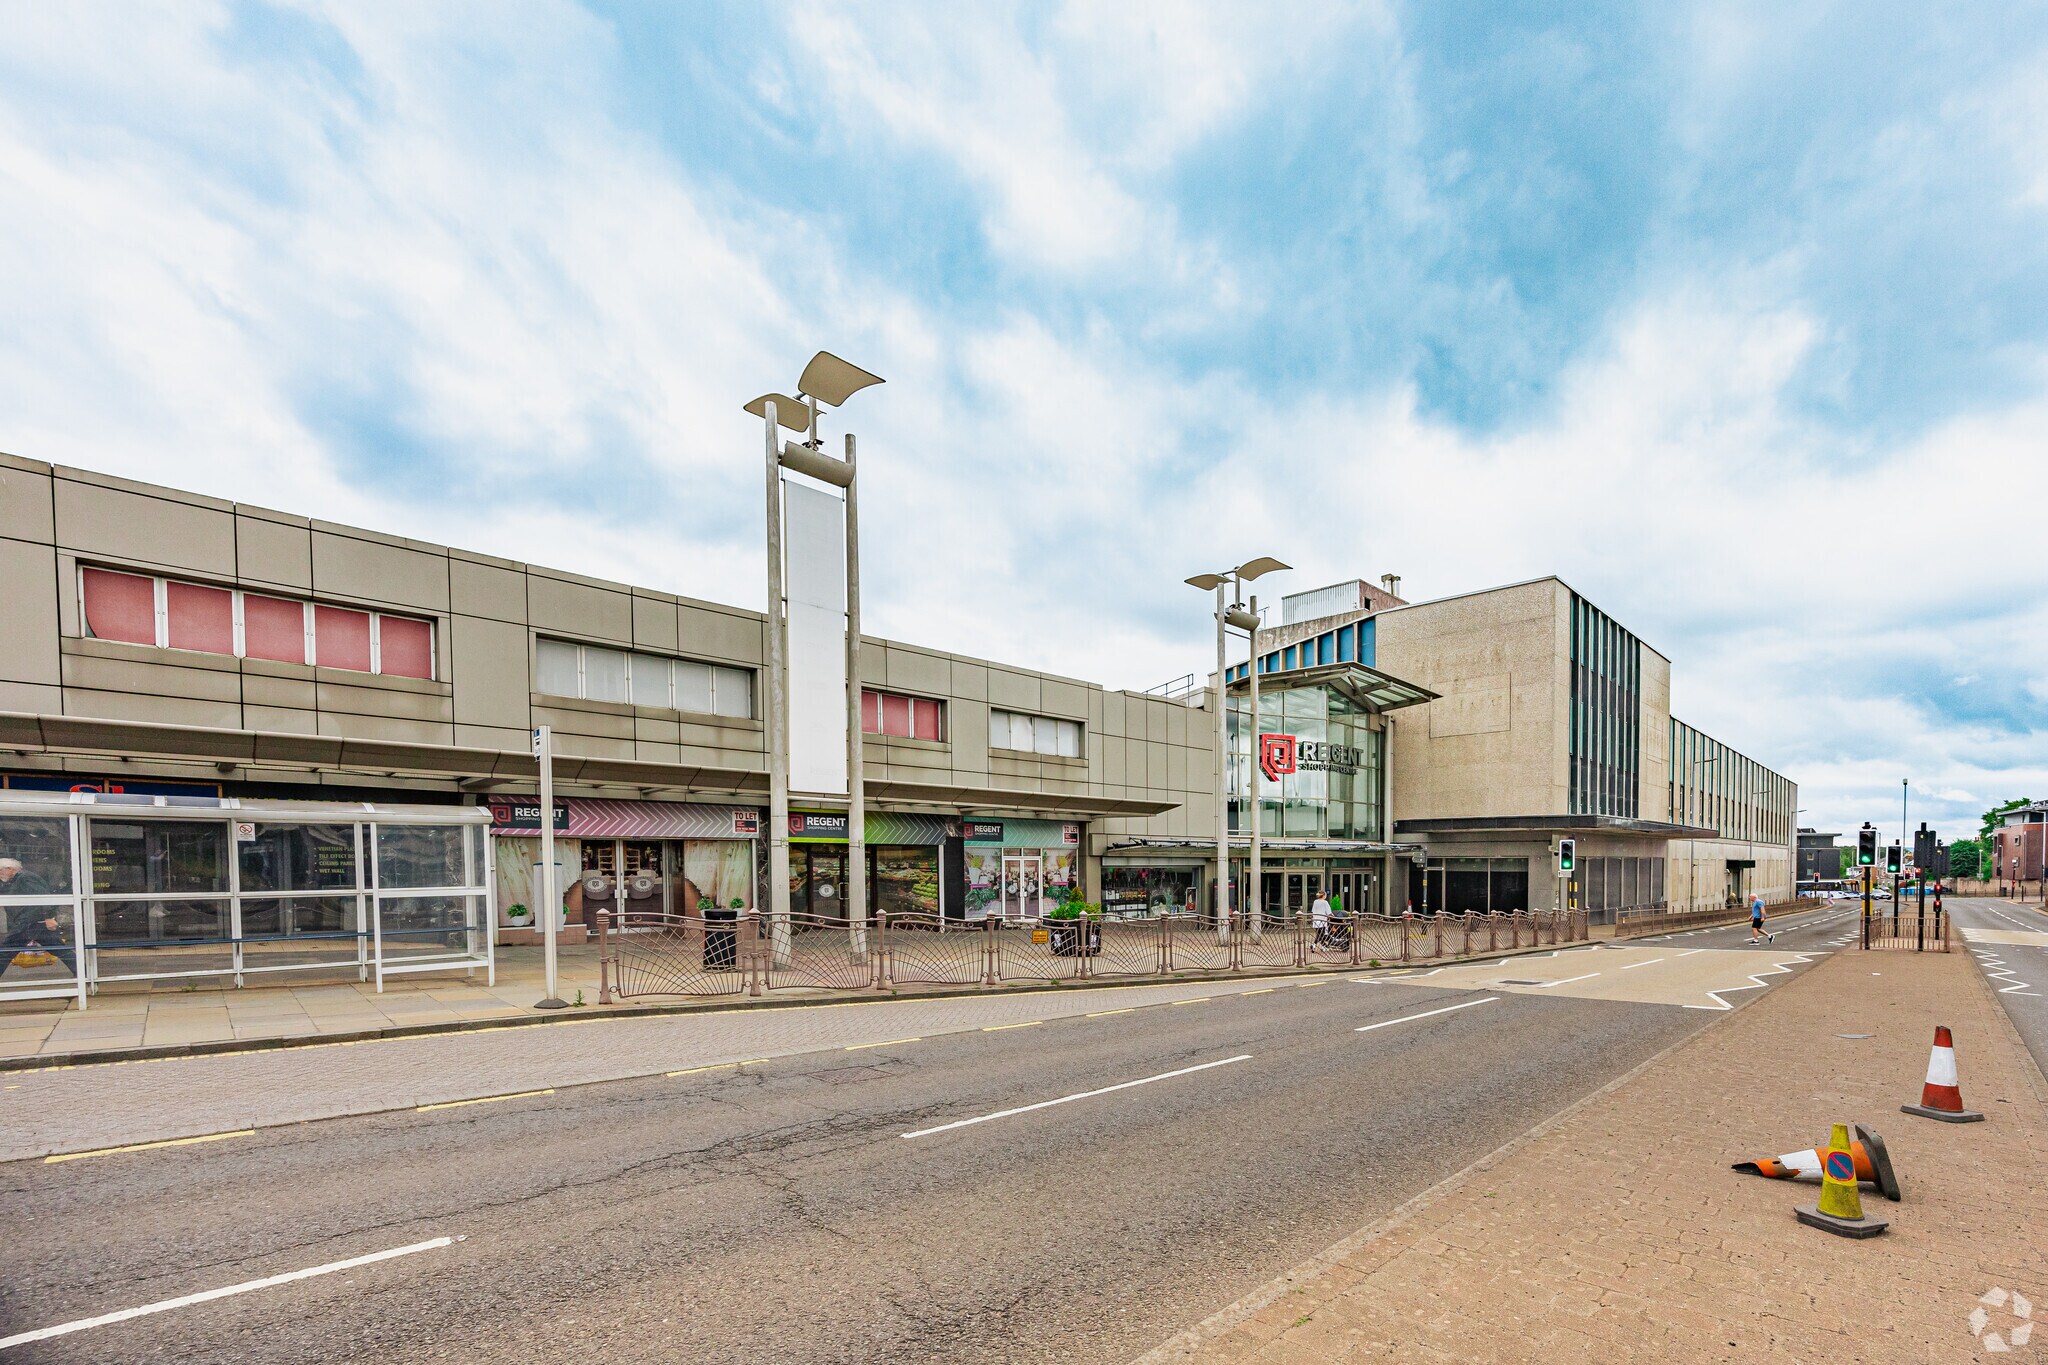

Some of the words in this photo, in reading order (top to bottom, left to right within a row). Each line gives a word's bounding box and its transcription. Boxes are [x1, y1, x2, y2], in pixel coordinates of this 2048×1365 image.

[1303, 741, 1364, 767] REGENT
[515, 807, 564, 818] REGT
[734, 812, 744, 820] TO
[745, 812, 757, 820] LET
[806, 816, 846, 827] REGENT
[974, 825, 1001, 833] REGENT
